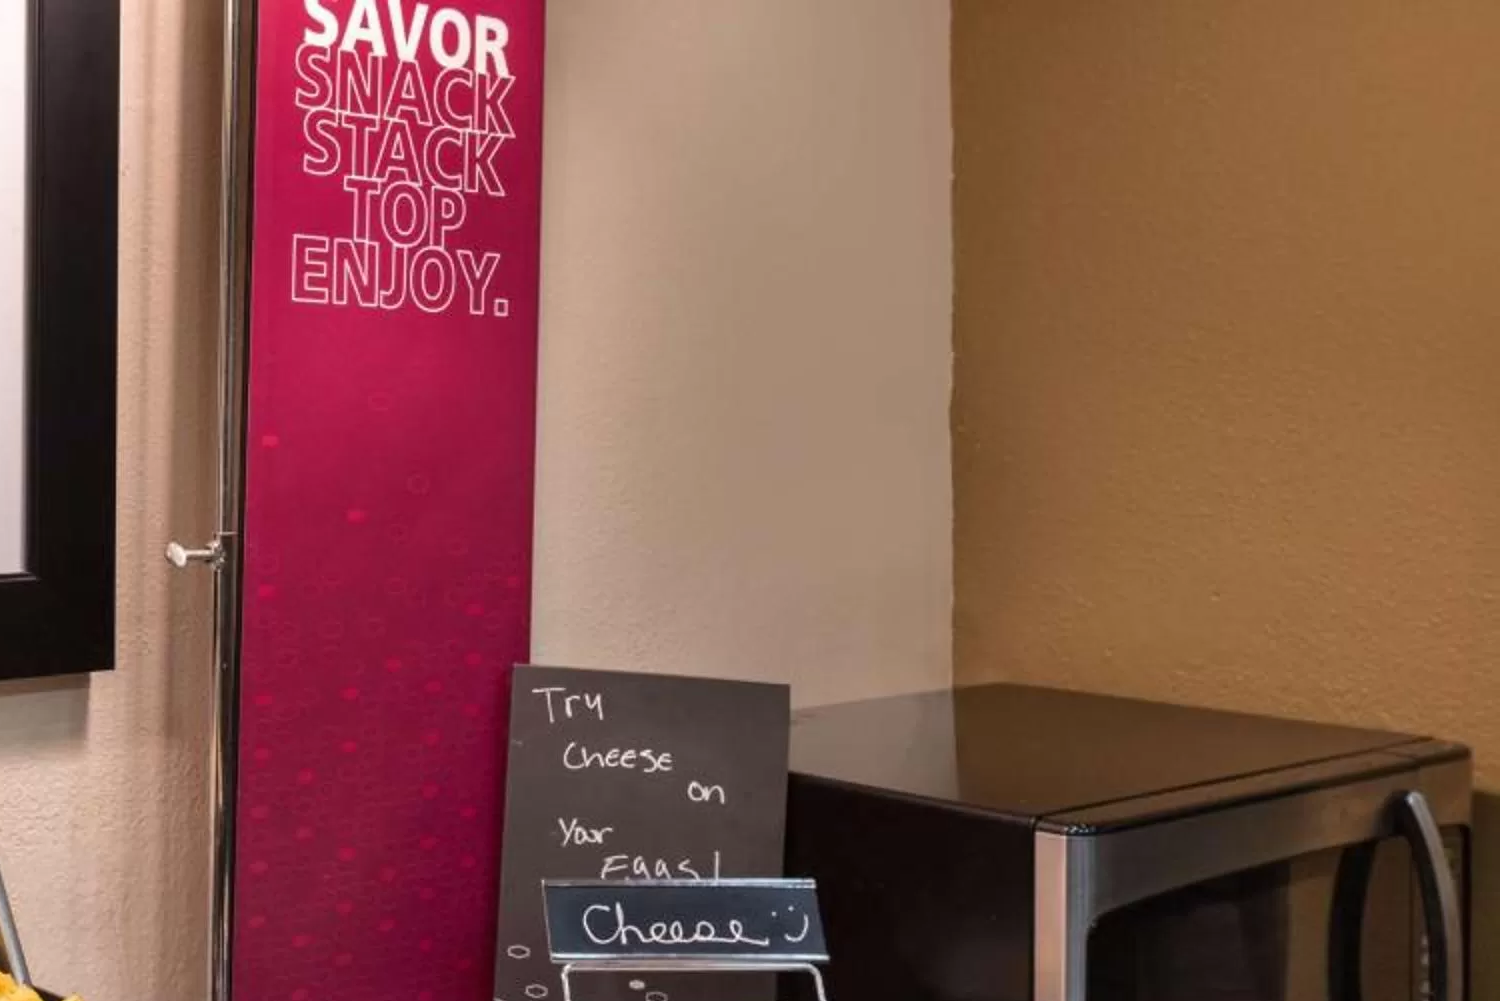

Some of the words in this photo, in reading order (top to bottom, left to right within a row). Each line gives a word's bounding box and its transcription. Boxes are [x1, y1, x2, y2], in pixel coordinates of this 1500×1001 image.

[303, 0, 511, 77] SAVOR
[294, 43, 516, 138] SNACK
[303, 108, 506, 197] STACK
[344, 176, 467, 250] TOP
[291, 233, 509, 317] ENJOY.
[531, 686, 605, 724] Try
[562, 741, 674, 773] Cheese
[686, 780, 726, 805] on
[582, 901, 770, 946] Cheese
